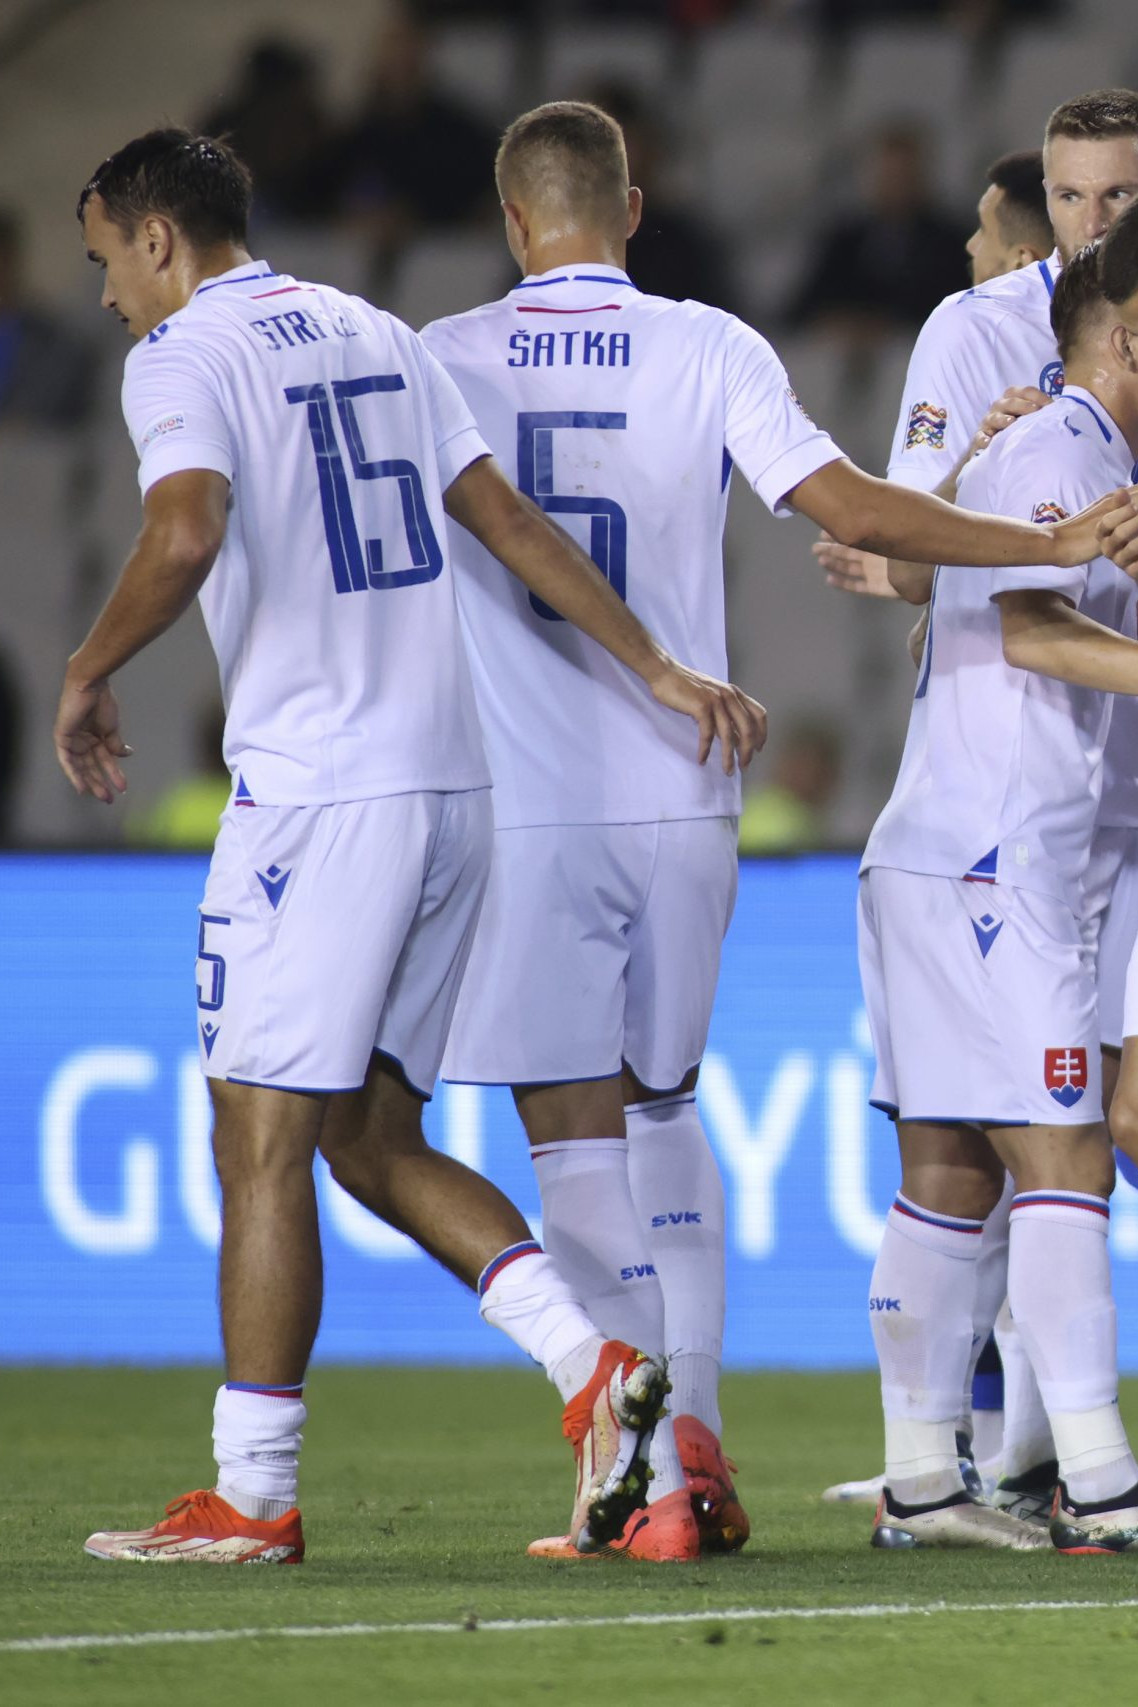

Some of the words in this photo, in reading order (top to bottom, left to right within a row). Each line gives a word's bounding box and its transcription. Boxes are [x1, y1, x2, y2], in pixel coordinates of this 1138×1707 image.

[508, 329, 630, 367] ŠATKA
[283, 374, 443, 594] 15
[517, 411, 627, 622] 5
[651, 1211, 703, 1228] SVK
[869, 1296, 902, 1312] SVK
